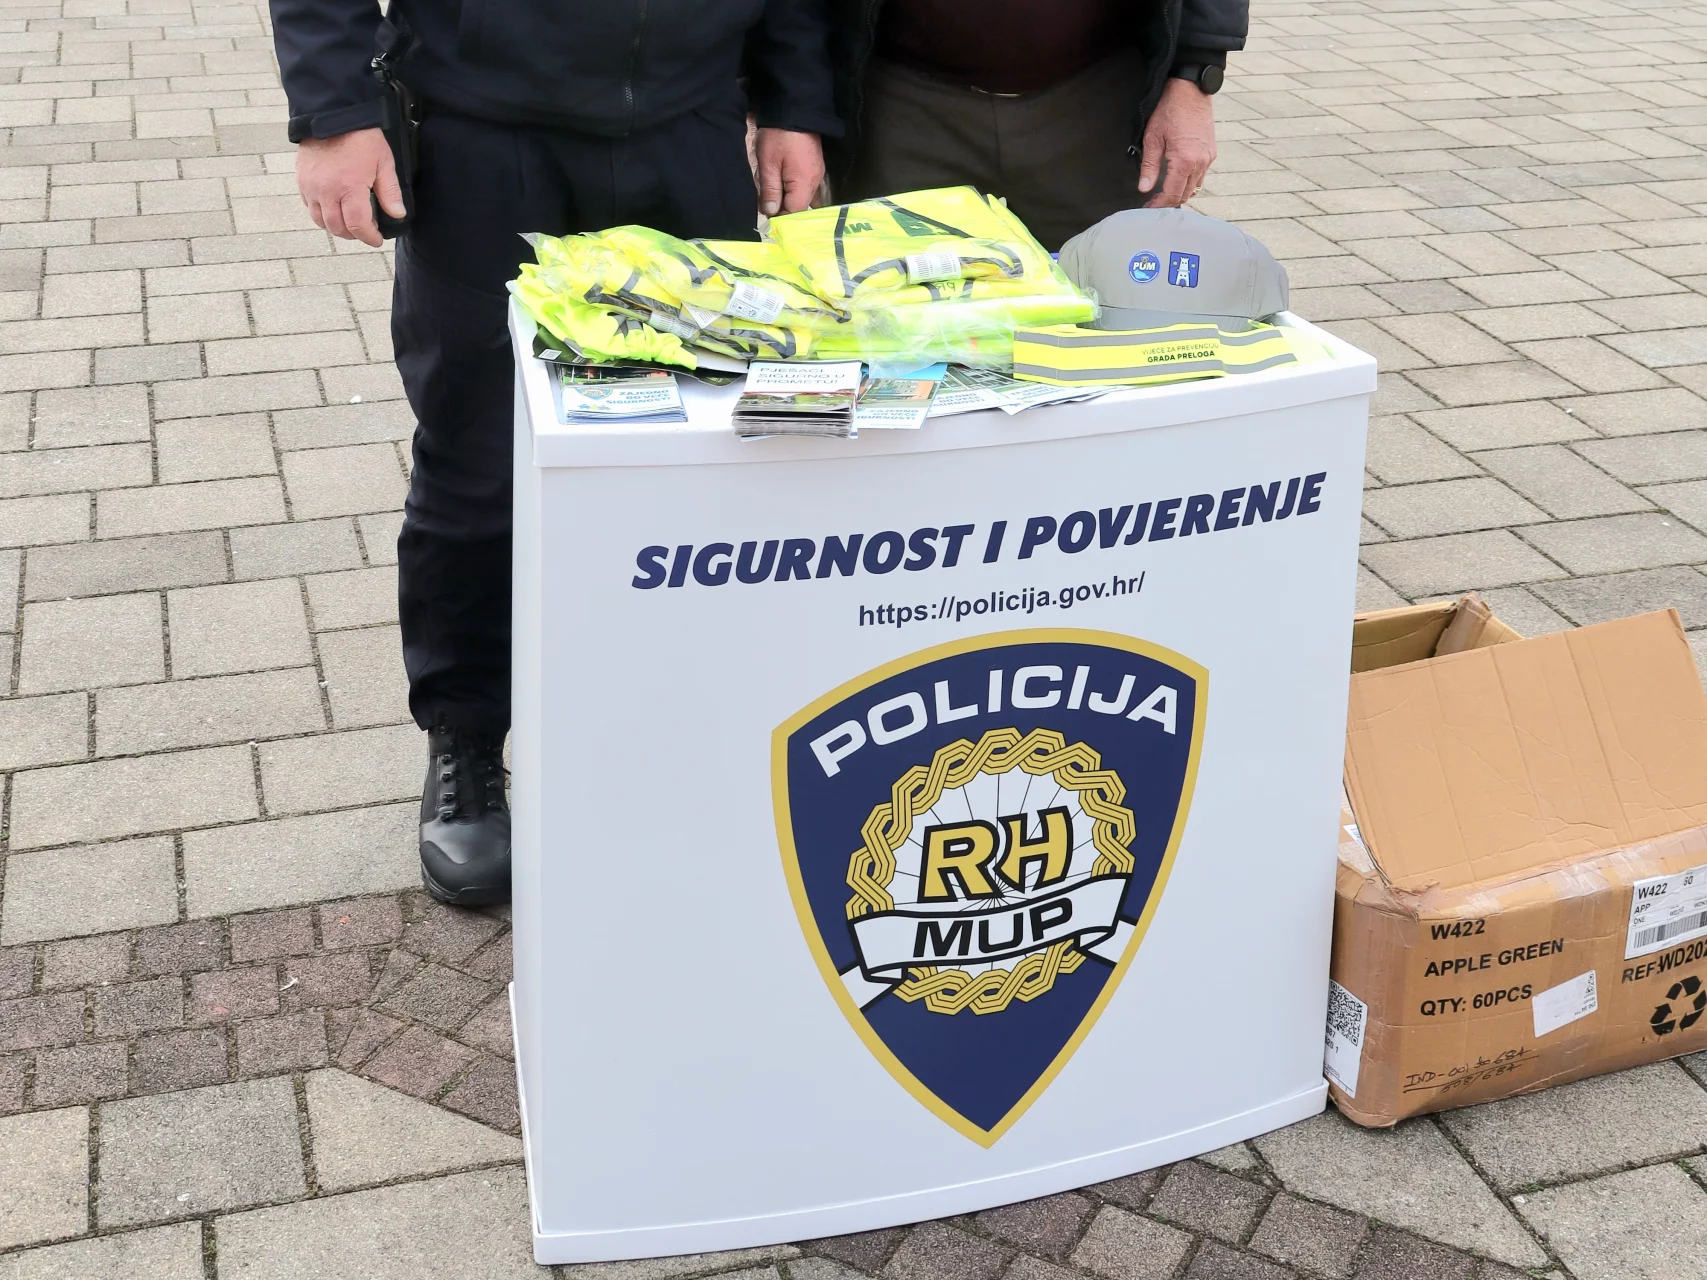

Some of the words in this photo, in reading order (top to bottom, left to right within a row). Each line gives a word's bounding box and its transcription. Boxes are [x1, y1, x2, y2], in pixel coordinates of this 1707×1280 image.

[1132, 261, 1156, 271] PUM
[1147, 353, 1175, 363] GRADA
[1177, 350, 1215, 360] PRELOGA
[1176, 342, 1219, 352] PREVENCIJU
[606, 396, 671, 405] SIGURNOSTI
[632, 523, 975, 589] SIGURNOST
[982, 521, 1008, 564] I
[1017, 472, 1327, 559] POVJERENJE
[858, 571, 1146, 628] https://policija.gov.hr/
[809, 665, 1179, 778] POLICIJA
[917, 806, 1074, 904] RH
[1638, 882, 1668, 899] W422
[1634, 903, 1651, 915] APP
[913, 897, 1074, 958] MUP
[1431, 919, 1485, 940] W422
[1633, 916, 1645, 925] ONE
[1424, 953, 1492, 977] APPLE
[1498, 938, 1564, 965] GREEN
[1420, 997, 1467, 1016] QTY:
[1472, 984, 1533, 1009] 60PCS
